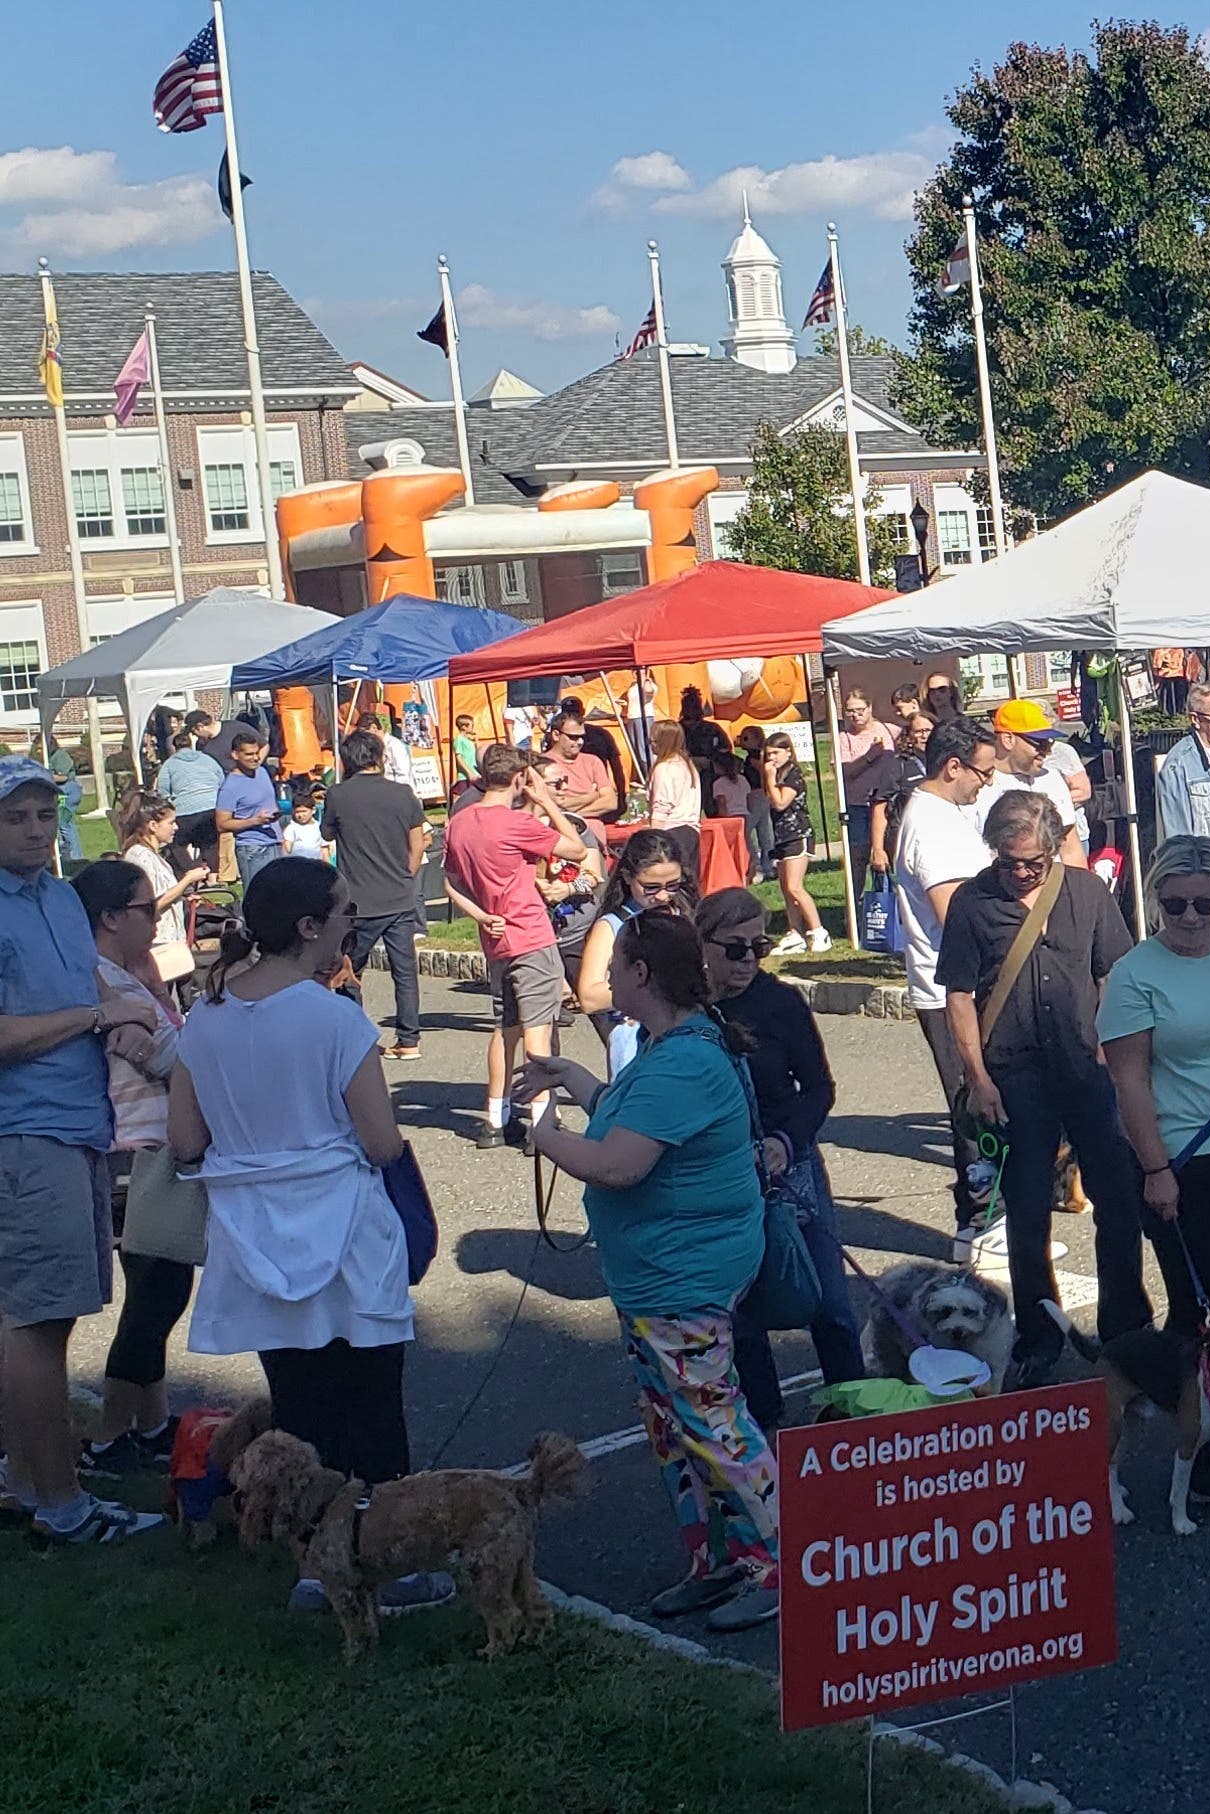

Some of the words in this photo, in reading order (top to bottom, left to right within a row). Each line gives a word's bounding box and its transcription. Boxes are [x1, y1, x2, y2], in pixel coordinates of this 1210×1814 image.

[800, 1447, 822, 1478] A
[830, 1420, 993, 1472] Celebration
[1001, 1410, 1029, 1443] of
[1035, 1404, 1091, 1437] Pets
[876, 1480, 897, 1507] is
[904, 1460, 990, 1502] hosted
[996, 1458, 1026, 1487] by
[801, 1517, 959, 1588] Church
[972, 1504, 1016, 1555] of
[1026, 1497, 1093, 1544] the
[836, 1595, 939, 1655] Holy
[951, 1567, 1068, 1633] Spirit
[822, 1632, 1084, 1708] holyspiritverona.org
